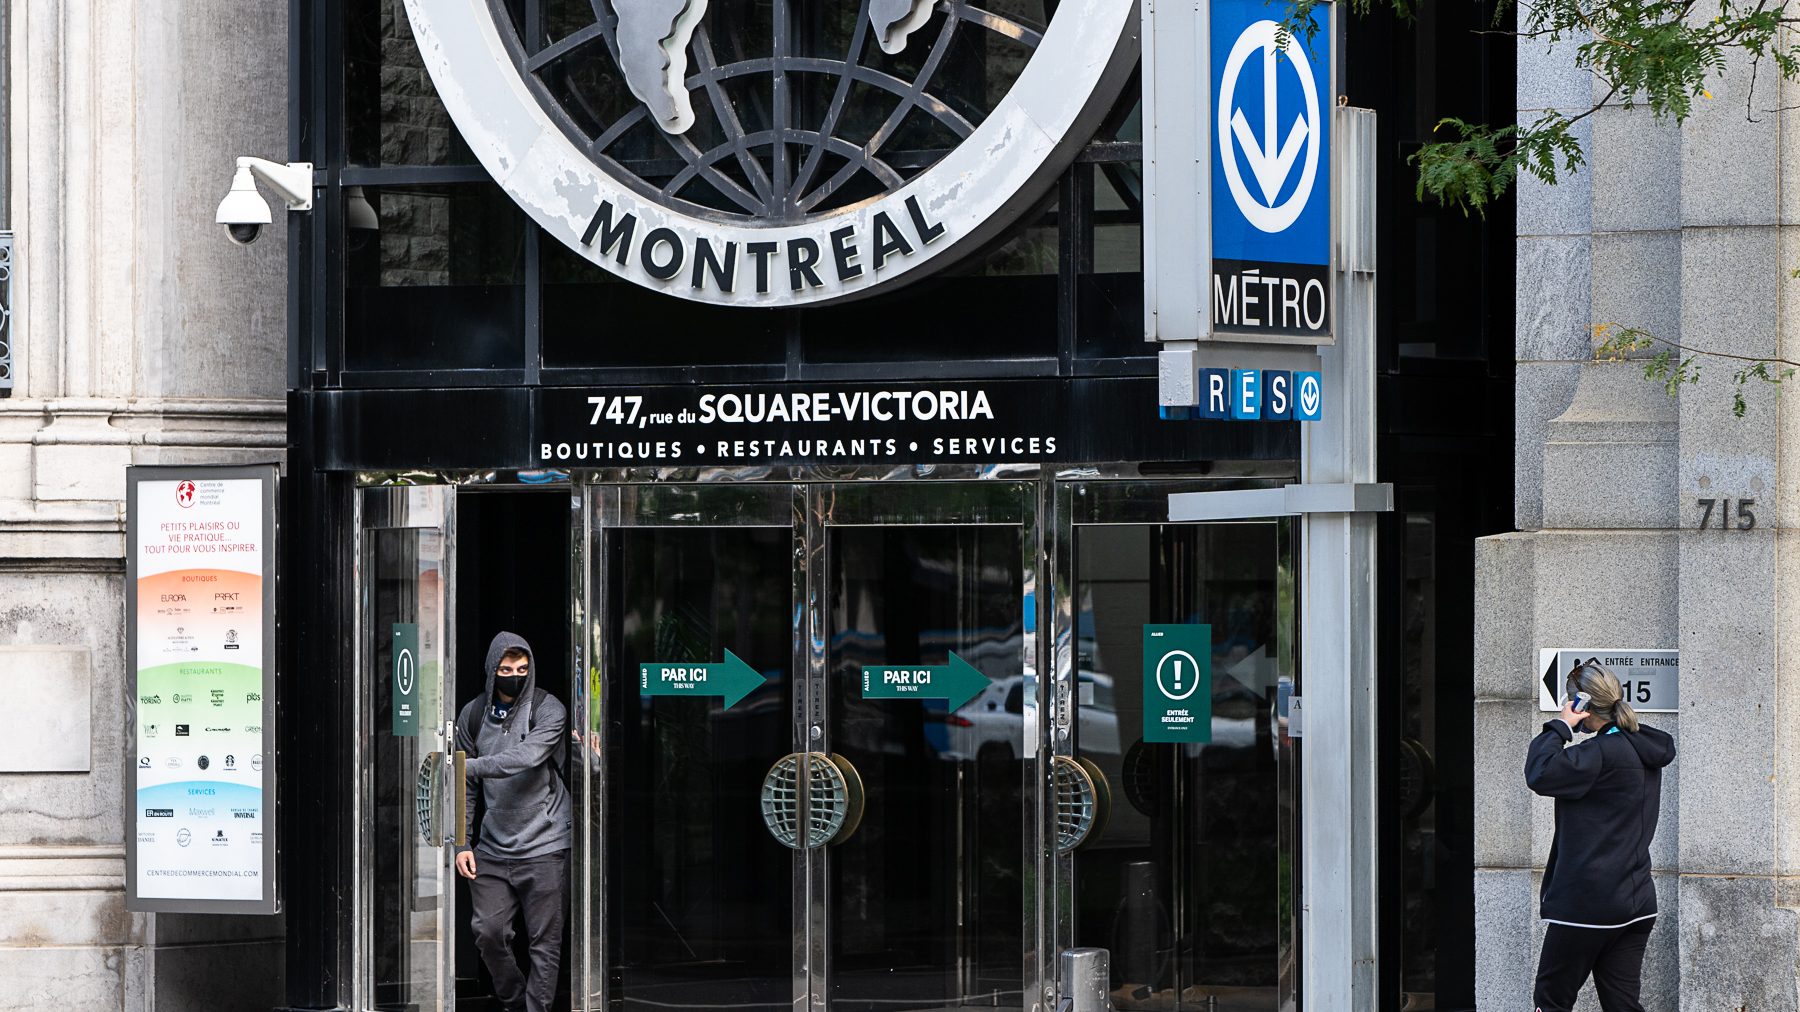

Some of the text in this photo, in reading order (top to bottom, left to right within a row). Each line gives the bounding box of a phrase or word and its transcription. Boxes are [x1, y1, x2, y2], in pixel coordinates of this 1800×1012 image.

[580, 193, 946, 293] MONTREAL
[1214, 269, 1326, 330] MÉTRO
[587, 390, 994, 429] 747, rue du SQUARE-VICTORIA
[541, 436, 1057, 460] BOUTIQUES RESTAURANTS SERVICES
[1698, 498, 1757, 531] 715
[160, 521, 240, 532] PETITS PLAISIRS OU
[168, 533, 181, 542] VIE
[145, 543, 258, 554] TOUT POUR VOUS INSPIRER.
[182, 575, 218, 583] BOUTIQUES
[1605, 656, 1679, 667] ENTRÉE ENTRANCE
[179, 667, 223, 675] RESTAURANTS
[661, 668, 707, 682] PAR ICI
[883, 670, 931, 684] PAR ICI
[1622, 680, 1651, 703] 15
[1166, 708, 1189, 716] ENTRÉE
[187, 788, 216, 796] SERVICES
[146, 869, 259, 877] CENTREDECOMMERCEMONDIAL.COM
